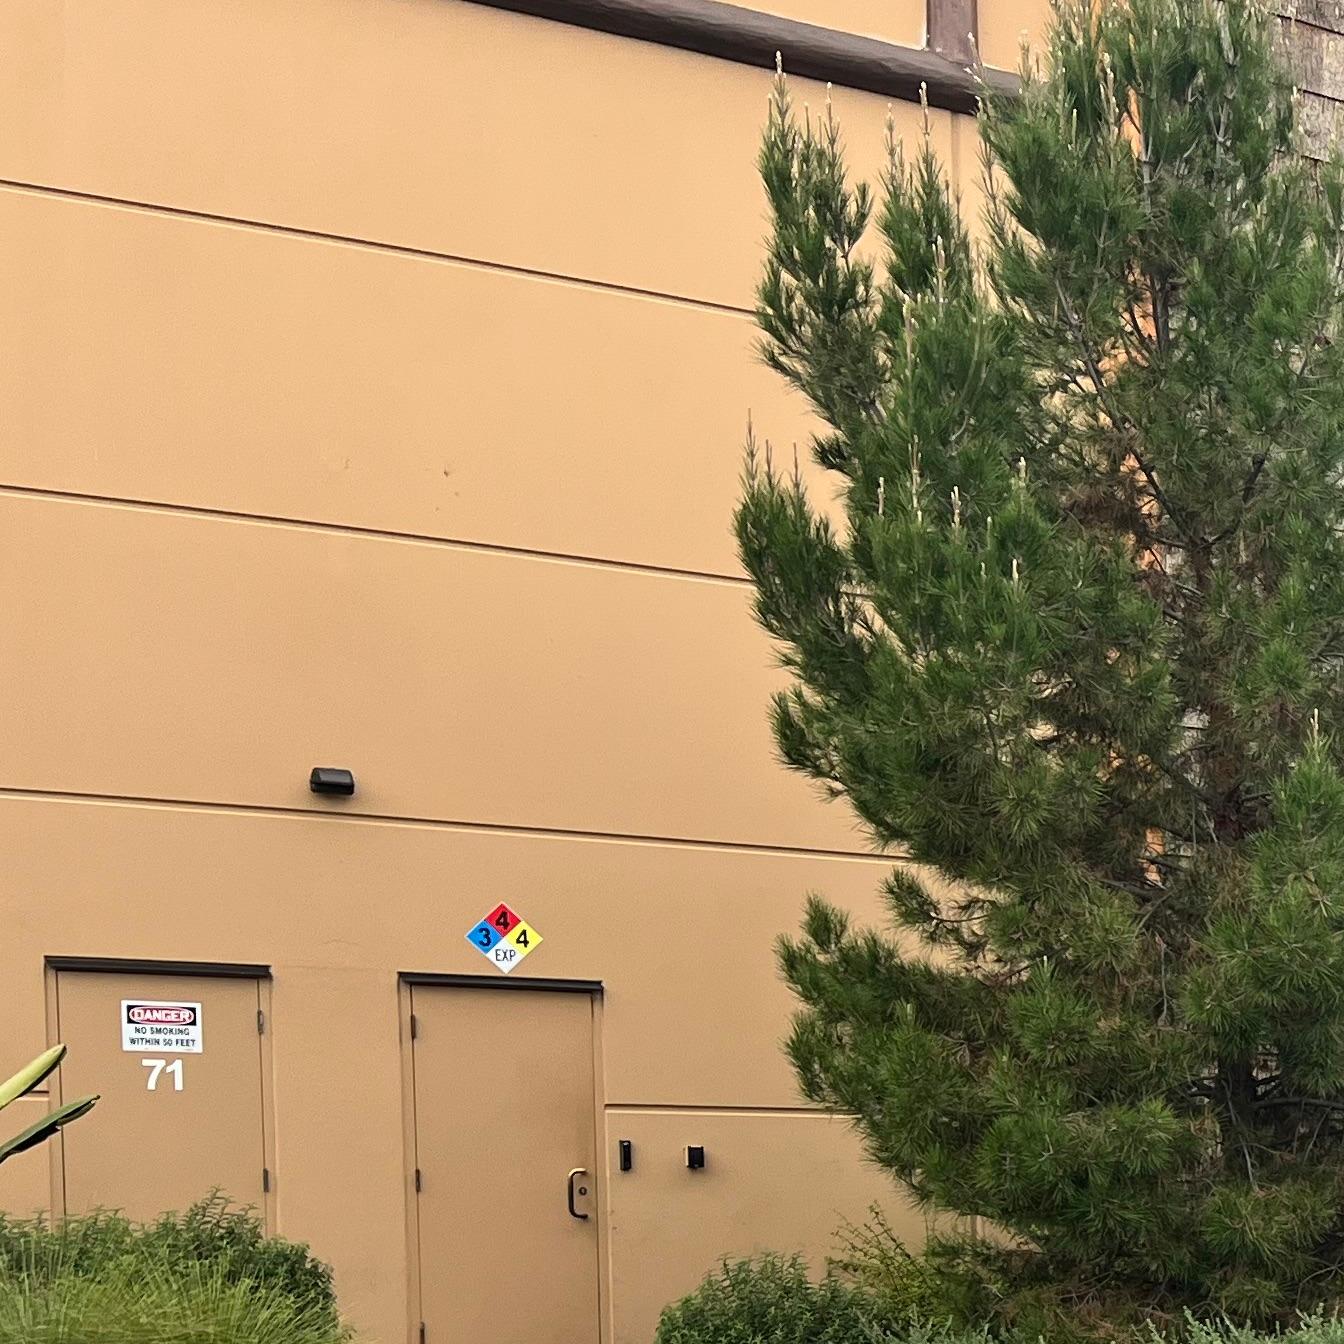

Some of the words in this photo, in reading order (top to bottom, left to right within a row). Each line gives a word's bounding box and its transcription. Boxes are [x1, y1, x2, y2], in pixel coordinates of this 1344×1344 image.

[495, 911, 510, 930] 4
[478, 928, 491, 946] 3
[516, 929, 529, 948] 4
[495, 949, 516, 961] EXP
[134, 1009, 190, 1022] DANGER
[134, 1026, 147, 1034] NO
[150, 1027, 190, 1036] SMOKING
[129, 1037, 160, 1046] WITHIN
[175, 1039, 196, 1047] FEET
[142, 1059, 183, 1091] 71
